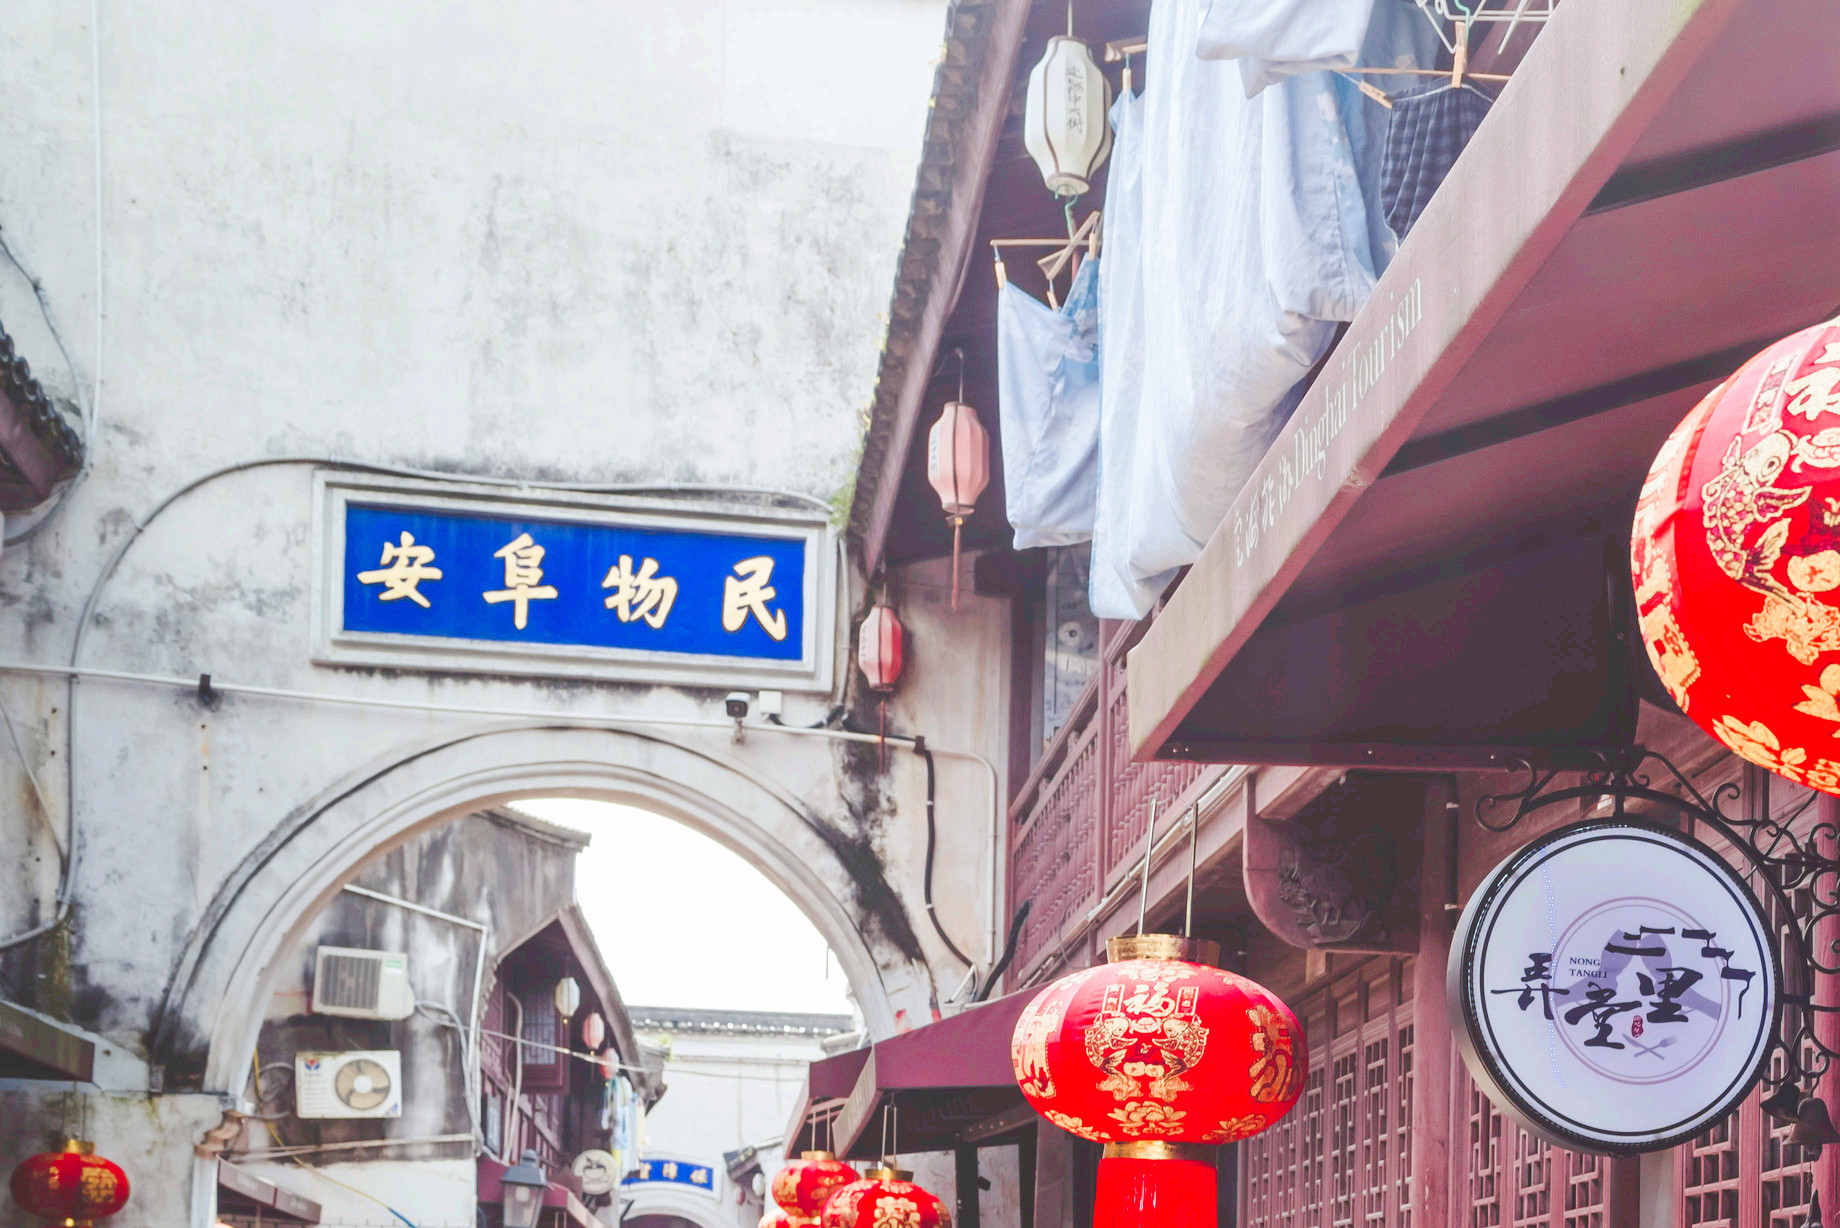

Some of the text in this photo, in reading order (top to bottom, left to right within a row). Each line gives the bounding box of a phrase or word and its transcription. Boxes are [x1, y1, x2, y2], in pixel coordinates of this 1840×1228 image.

[1293, 358, 1348, 488] Dinghai
[1348, 276, 1424, 412] Tourism
[1570, 957, 1600, 967] NONG
[1123, 982, 1176, 1017] 福
